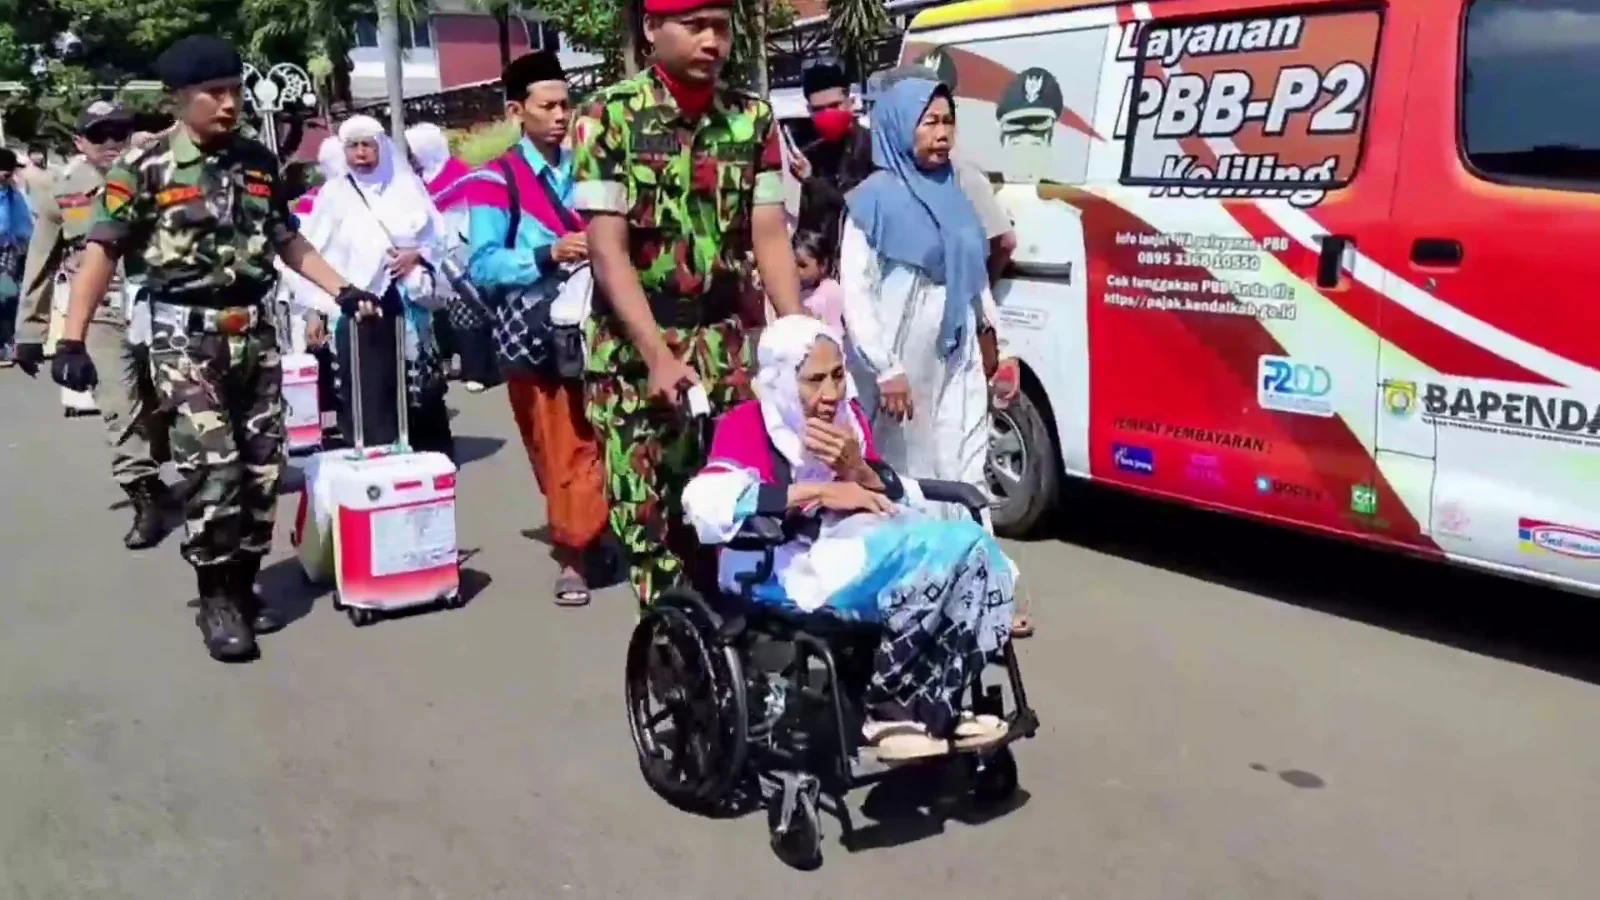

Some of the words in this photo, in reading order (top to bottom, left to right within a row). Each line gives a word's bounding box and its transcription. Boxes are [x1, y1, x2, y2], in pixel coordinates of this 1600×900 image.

[1115, 16, 1305, 67] Layanan
[1113, 61, 1369, 139] PBB-P2
[1137, 250, 1171, 266] 0895
[1212, 254, 1261, 271] 10550
[1163, 423, 1265, 453] PEMBAYARAN
